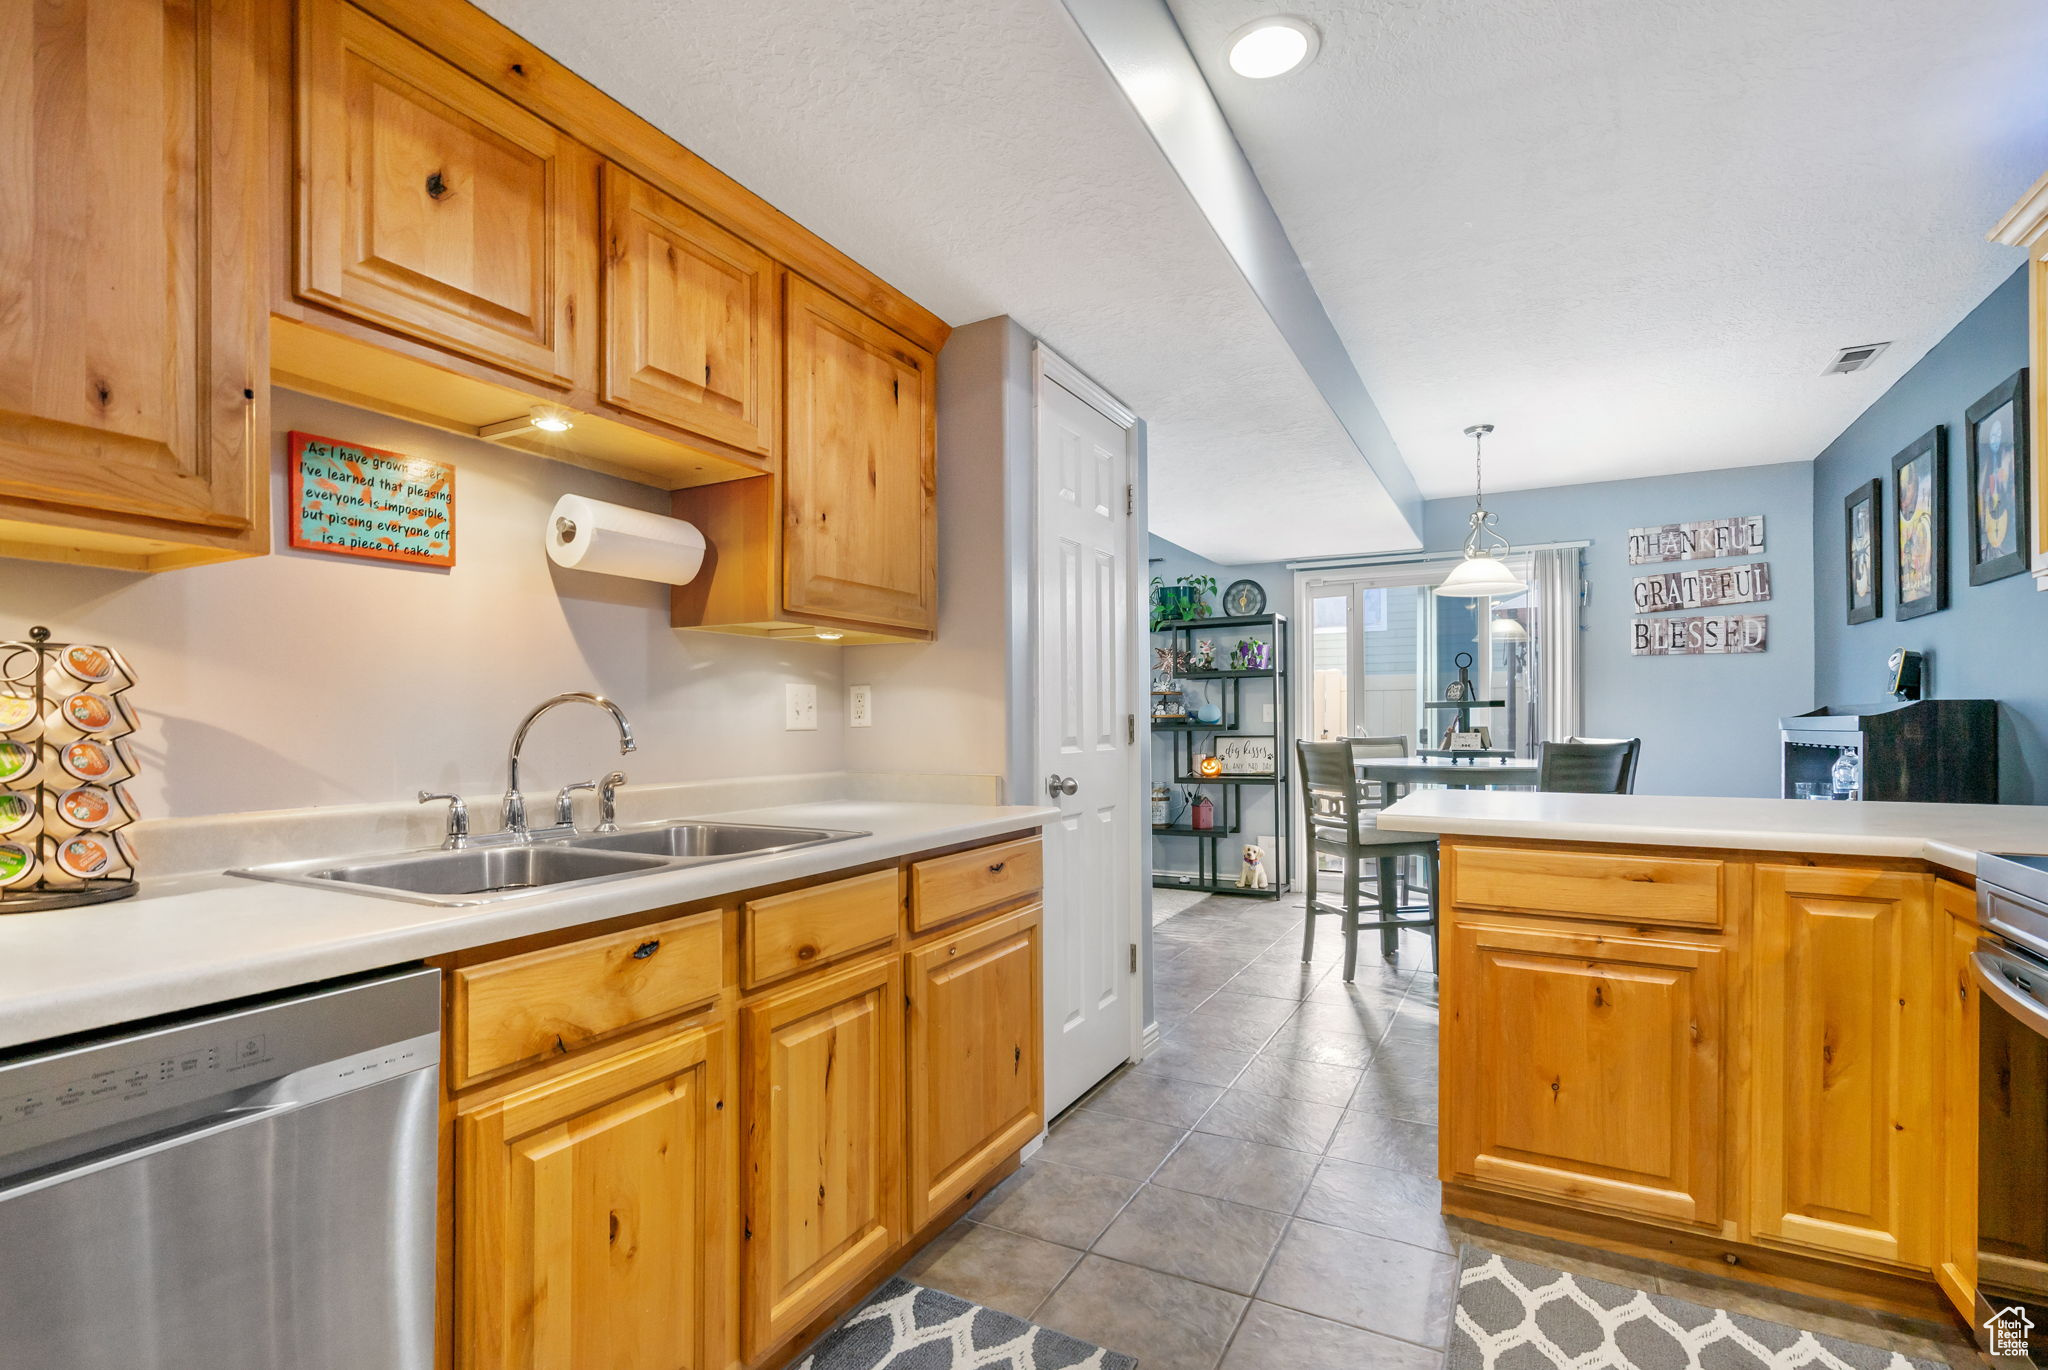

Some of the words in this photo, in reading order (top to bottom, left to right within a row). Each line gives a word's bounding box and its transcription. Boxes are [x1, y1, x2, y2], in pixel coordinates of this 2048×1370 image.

[309, 442, 325, 457] As
[340, 448, 368, 465] have
[373, 456, 408, 473] grown
[299, 462, 322, 477] I've
[328, 468, 375, 487] learned
[379, 478, 403, 492] that
[407, 485, 452, 504] pleasing
[305, 488, 365, 507] everyone
[369, 499, 380, 509] is
[384, 500, 447, 522] impossible,
[302, 507, 325, 521] but
[328, 513, 372, 531] pissing
[377, 523, 430, 539] everyone
[434, 529, 450, 540] off
[322, 532, 334, 544] is
[338, 537, 346, 545] a
[350, 537, 383, 551] piece
[387, 543, 399, 553] of
[404, 545, 433, 558] cake.
[1631, 524, 1764, 557] THANKFUL
[1635, 568, 1768, 608] GRATEFUL
[1635, 619, 1762, 649] BLESSED
[1225, 743, 1239, 759] dog
[1244, 740, 1267, 758] kisses
